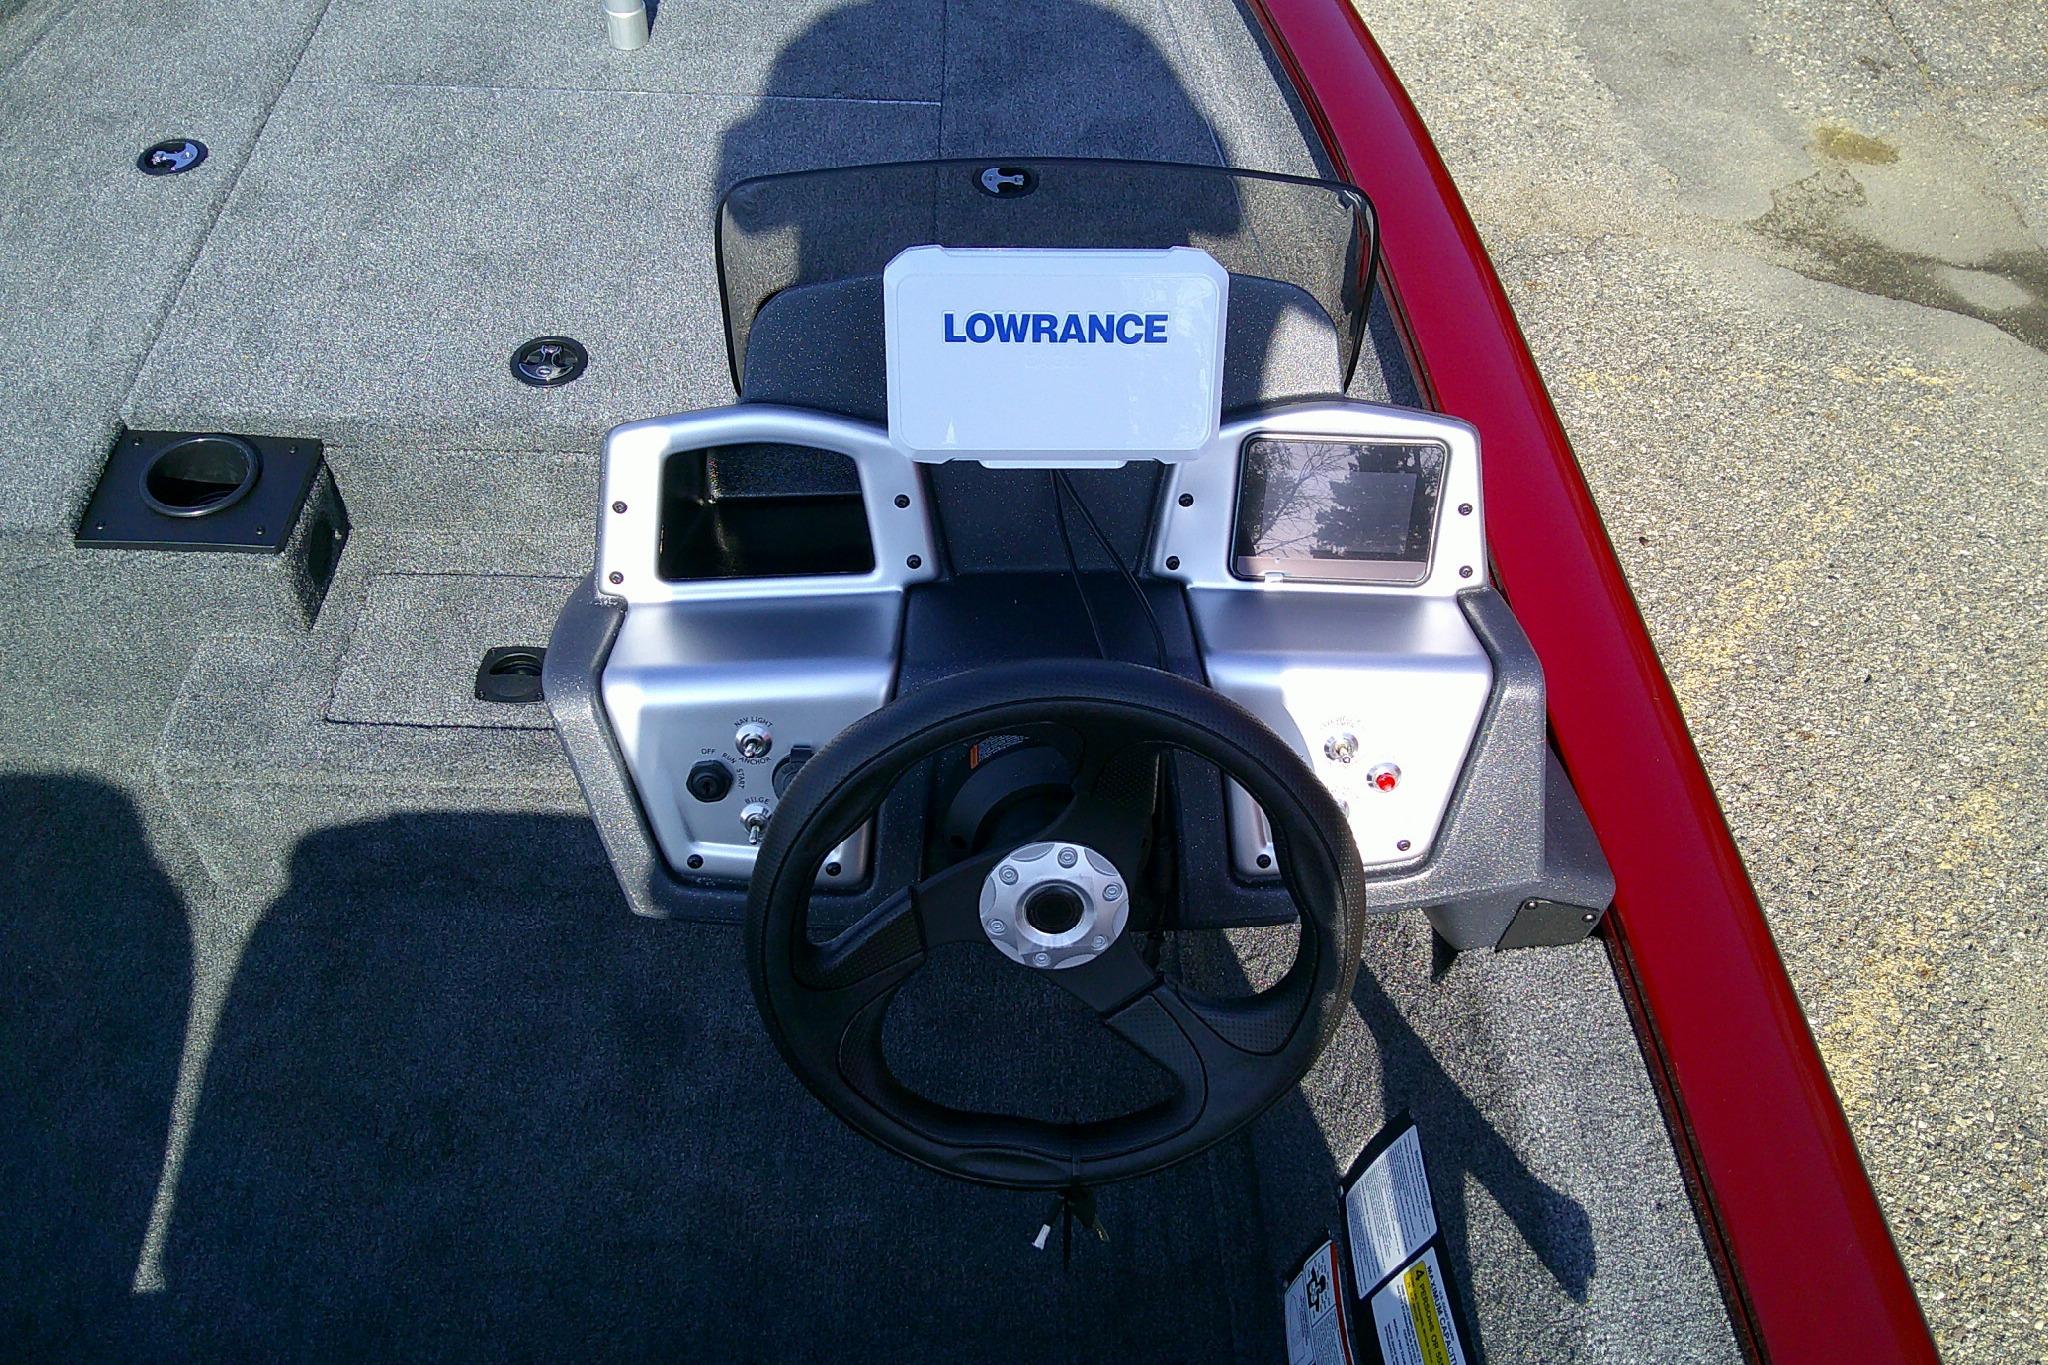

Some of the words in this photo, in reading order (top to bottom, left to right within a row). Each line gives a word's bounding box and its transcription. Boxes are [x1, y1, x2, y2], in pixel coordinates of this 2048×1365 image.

[944, 313, 1169, 345] LOWRANCE
[734, 716, 749, 728] NAV
[751, 716, 773, 728] LIGHT
[722, 752, 737, 764] RUN
[739, 756, 771, 765] ANCHOR
[736, 768, 745, 789] START
[744, 796, 769, 804] BILGE
[1427, 1264, 1443, 1316] MAXIMUM
[1415, 1269, 1425, 1281] 4
[1420, 1283, 1434, 1332] PERSONS
[1431, 1334, 1439, 1349] OR
